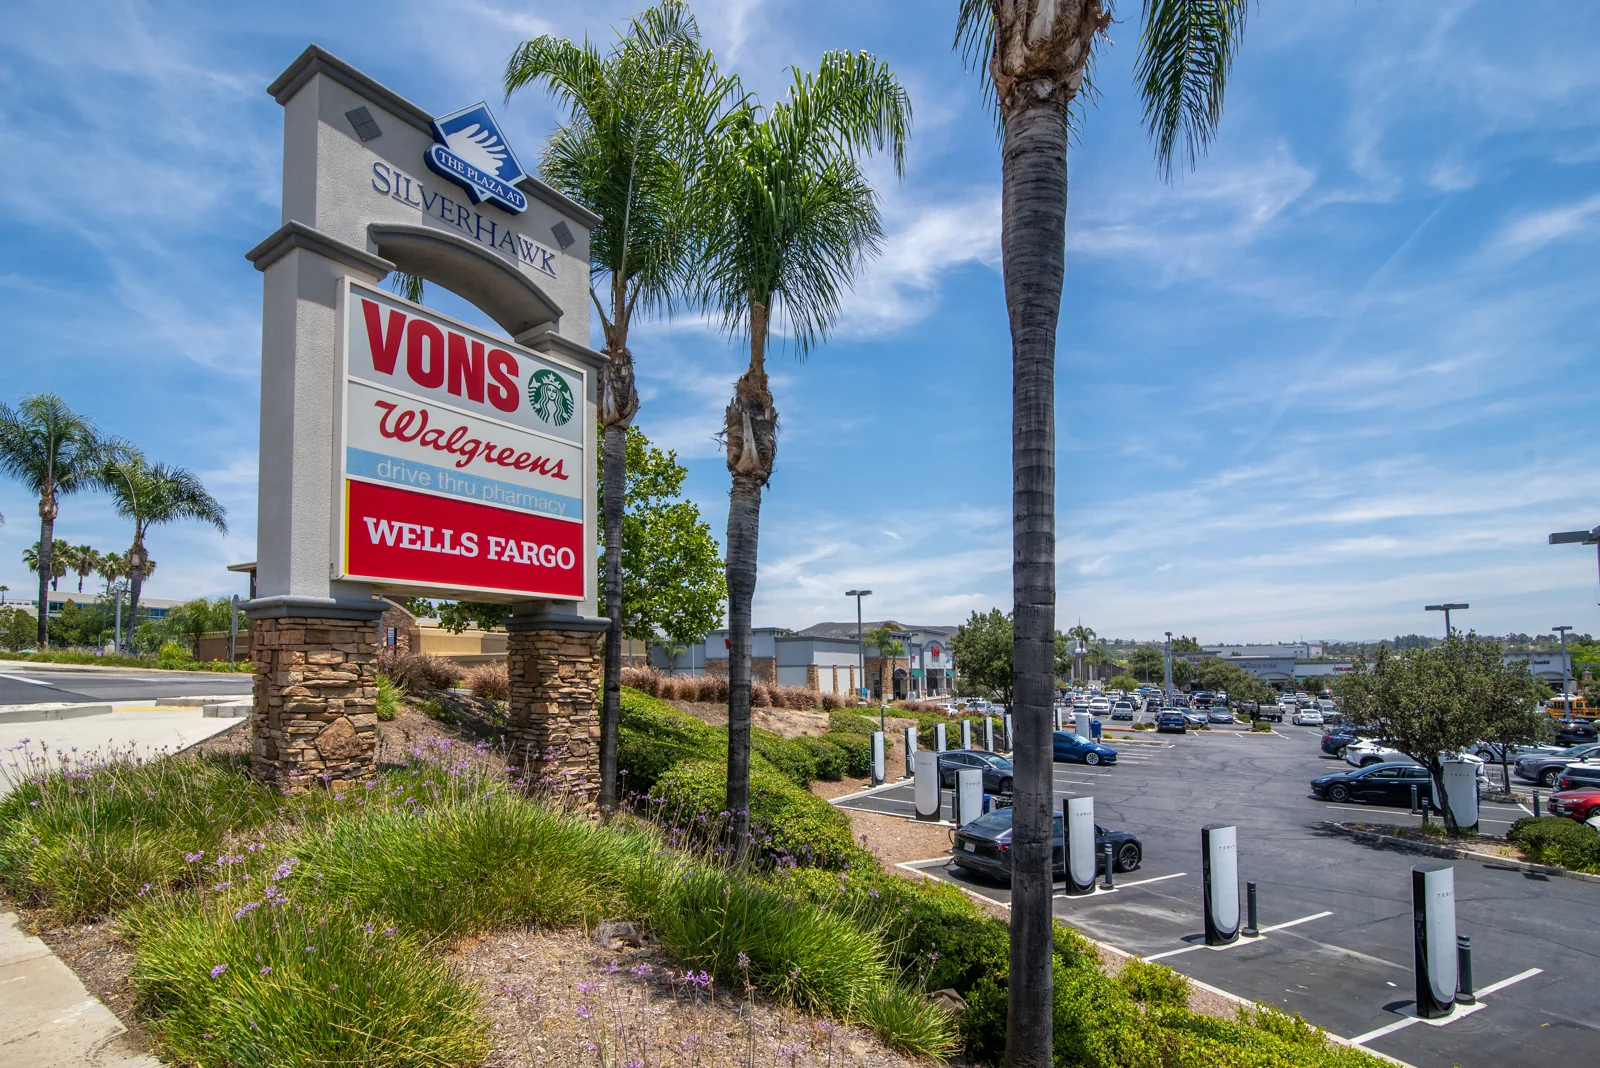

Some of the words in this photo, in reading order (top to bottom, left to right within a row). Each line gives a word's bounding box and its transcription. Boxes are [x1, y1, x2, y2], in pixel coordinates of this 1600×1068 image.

[439, 151, 464, 174] THE
[467, 167, 504, 196] PLAZA
[507, 191, 522, 205] AT
[372, 161, 556, 276] SILVERHAWK
[361, 298, 520, 413] VONS
[374, 400, 569, 481] Walgreens
[377, 459, 431, 486] drive
[437, 471, 476, 496] thru
[482, 484, 566, 517] pharmacy
[363, 516, 479, 558] WELLS
[487, 535, 576, 571] FARGO
